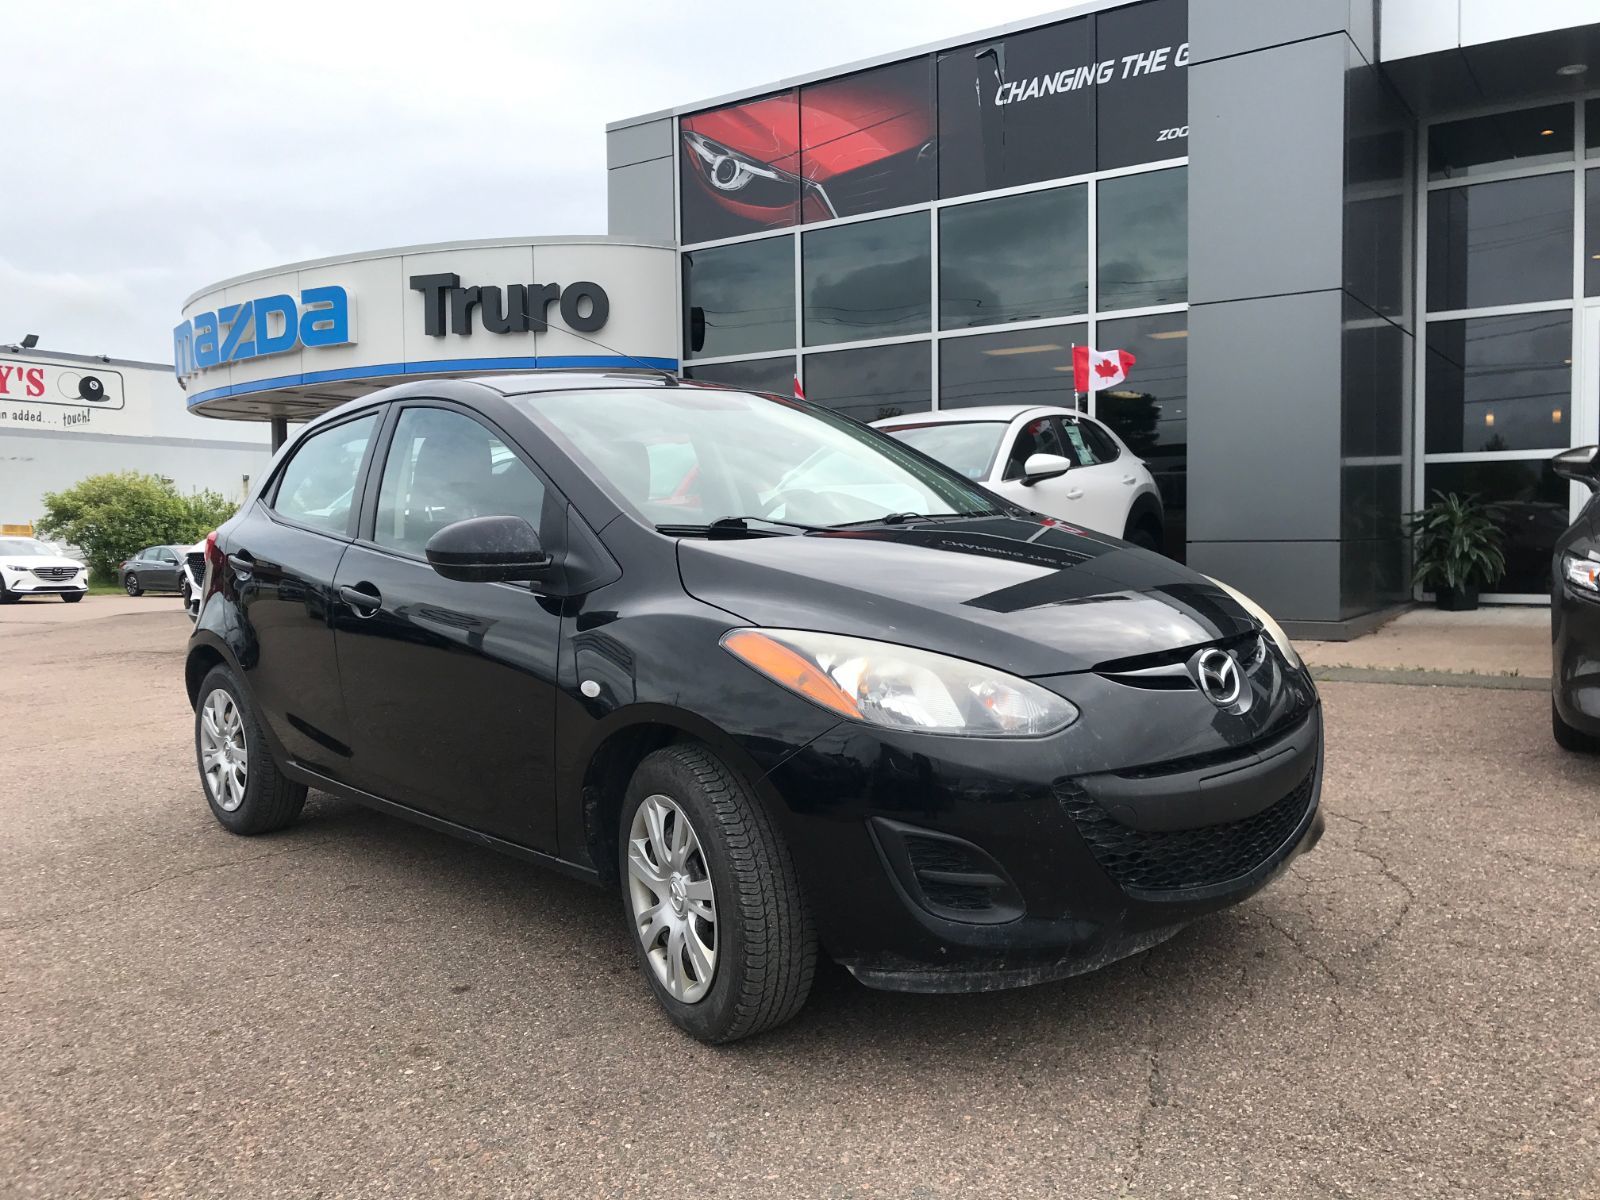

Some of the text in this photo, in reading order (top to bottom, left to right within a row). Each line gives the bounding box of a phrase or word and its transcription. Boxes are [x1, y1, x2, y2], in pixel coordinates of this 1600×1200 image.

[995, 59, 1115, 106] CHANGING
[1121, 46, 1172, 80] THE
[410, 272, 609, 338] Truro
